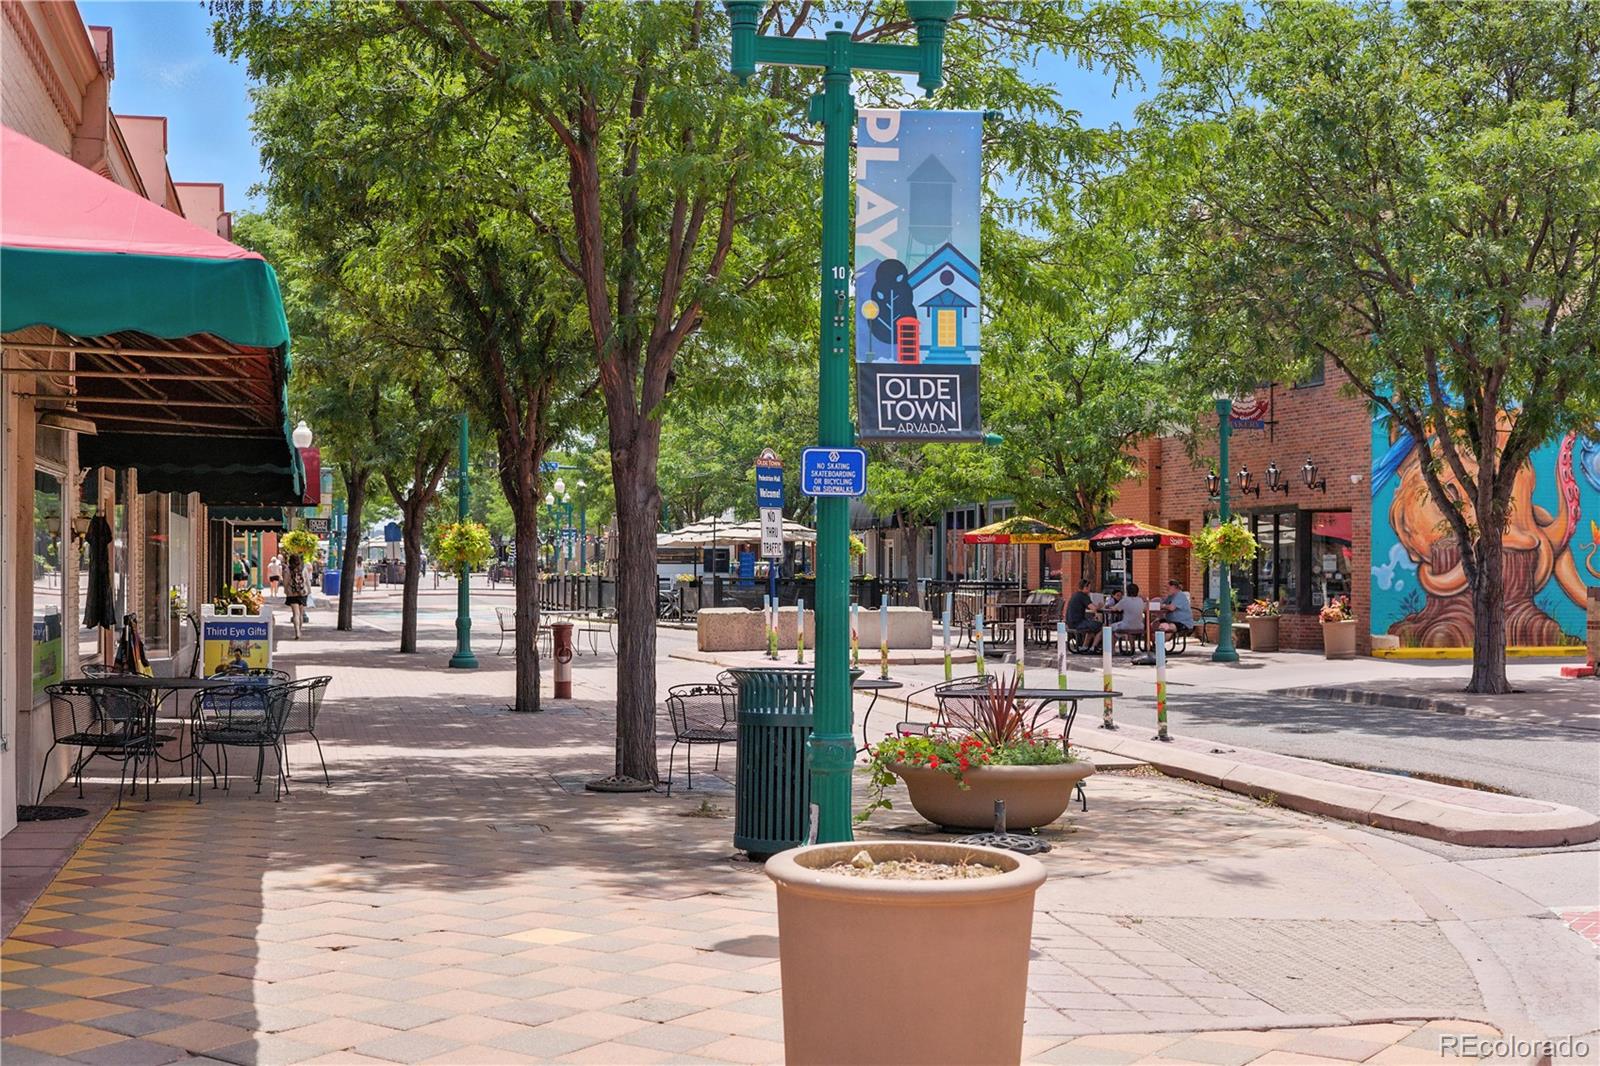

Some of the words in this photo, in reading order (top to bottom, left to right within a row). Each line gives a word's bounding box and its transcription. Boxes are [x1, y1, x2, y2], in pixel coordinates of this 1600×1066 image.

[856, 110, 901, 261] PLAY
[831, 266, 846, 279] 10
[885, 378, 951, 399] OLDE
[881, 400, 957, 421] TOWN
[896, 422, 948, 434] ARVADA
[816, 462, 826, 470] NO
[827, 462, 851, 470] SKATING
[810, 470, 857, 478] SKATEBOARDING
[813, 478, 823, 486] OR
[823, 478, 854, 486] BICYCLING
[759, 488, 781, 498] Welcome!
[767, 511, 776, 522] NO
[765, 526, 779, 538] THRU
[763, 542, 782, 554] TRAFFIC
[206, 627, 228, 636] Third
[229, 627, 246, 638] Eye
[247, 627, 267, 636] Gifts
